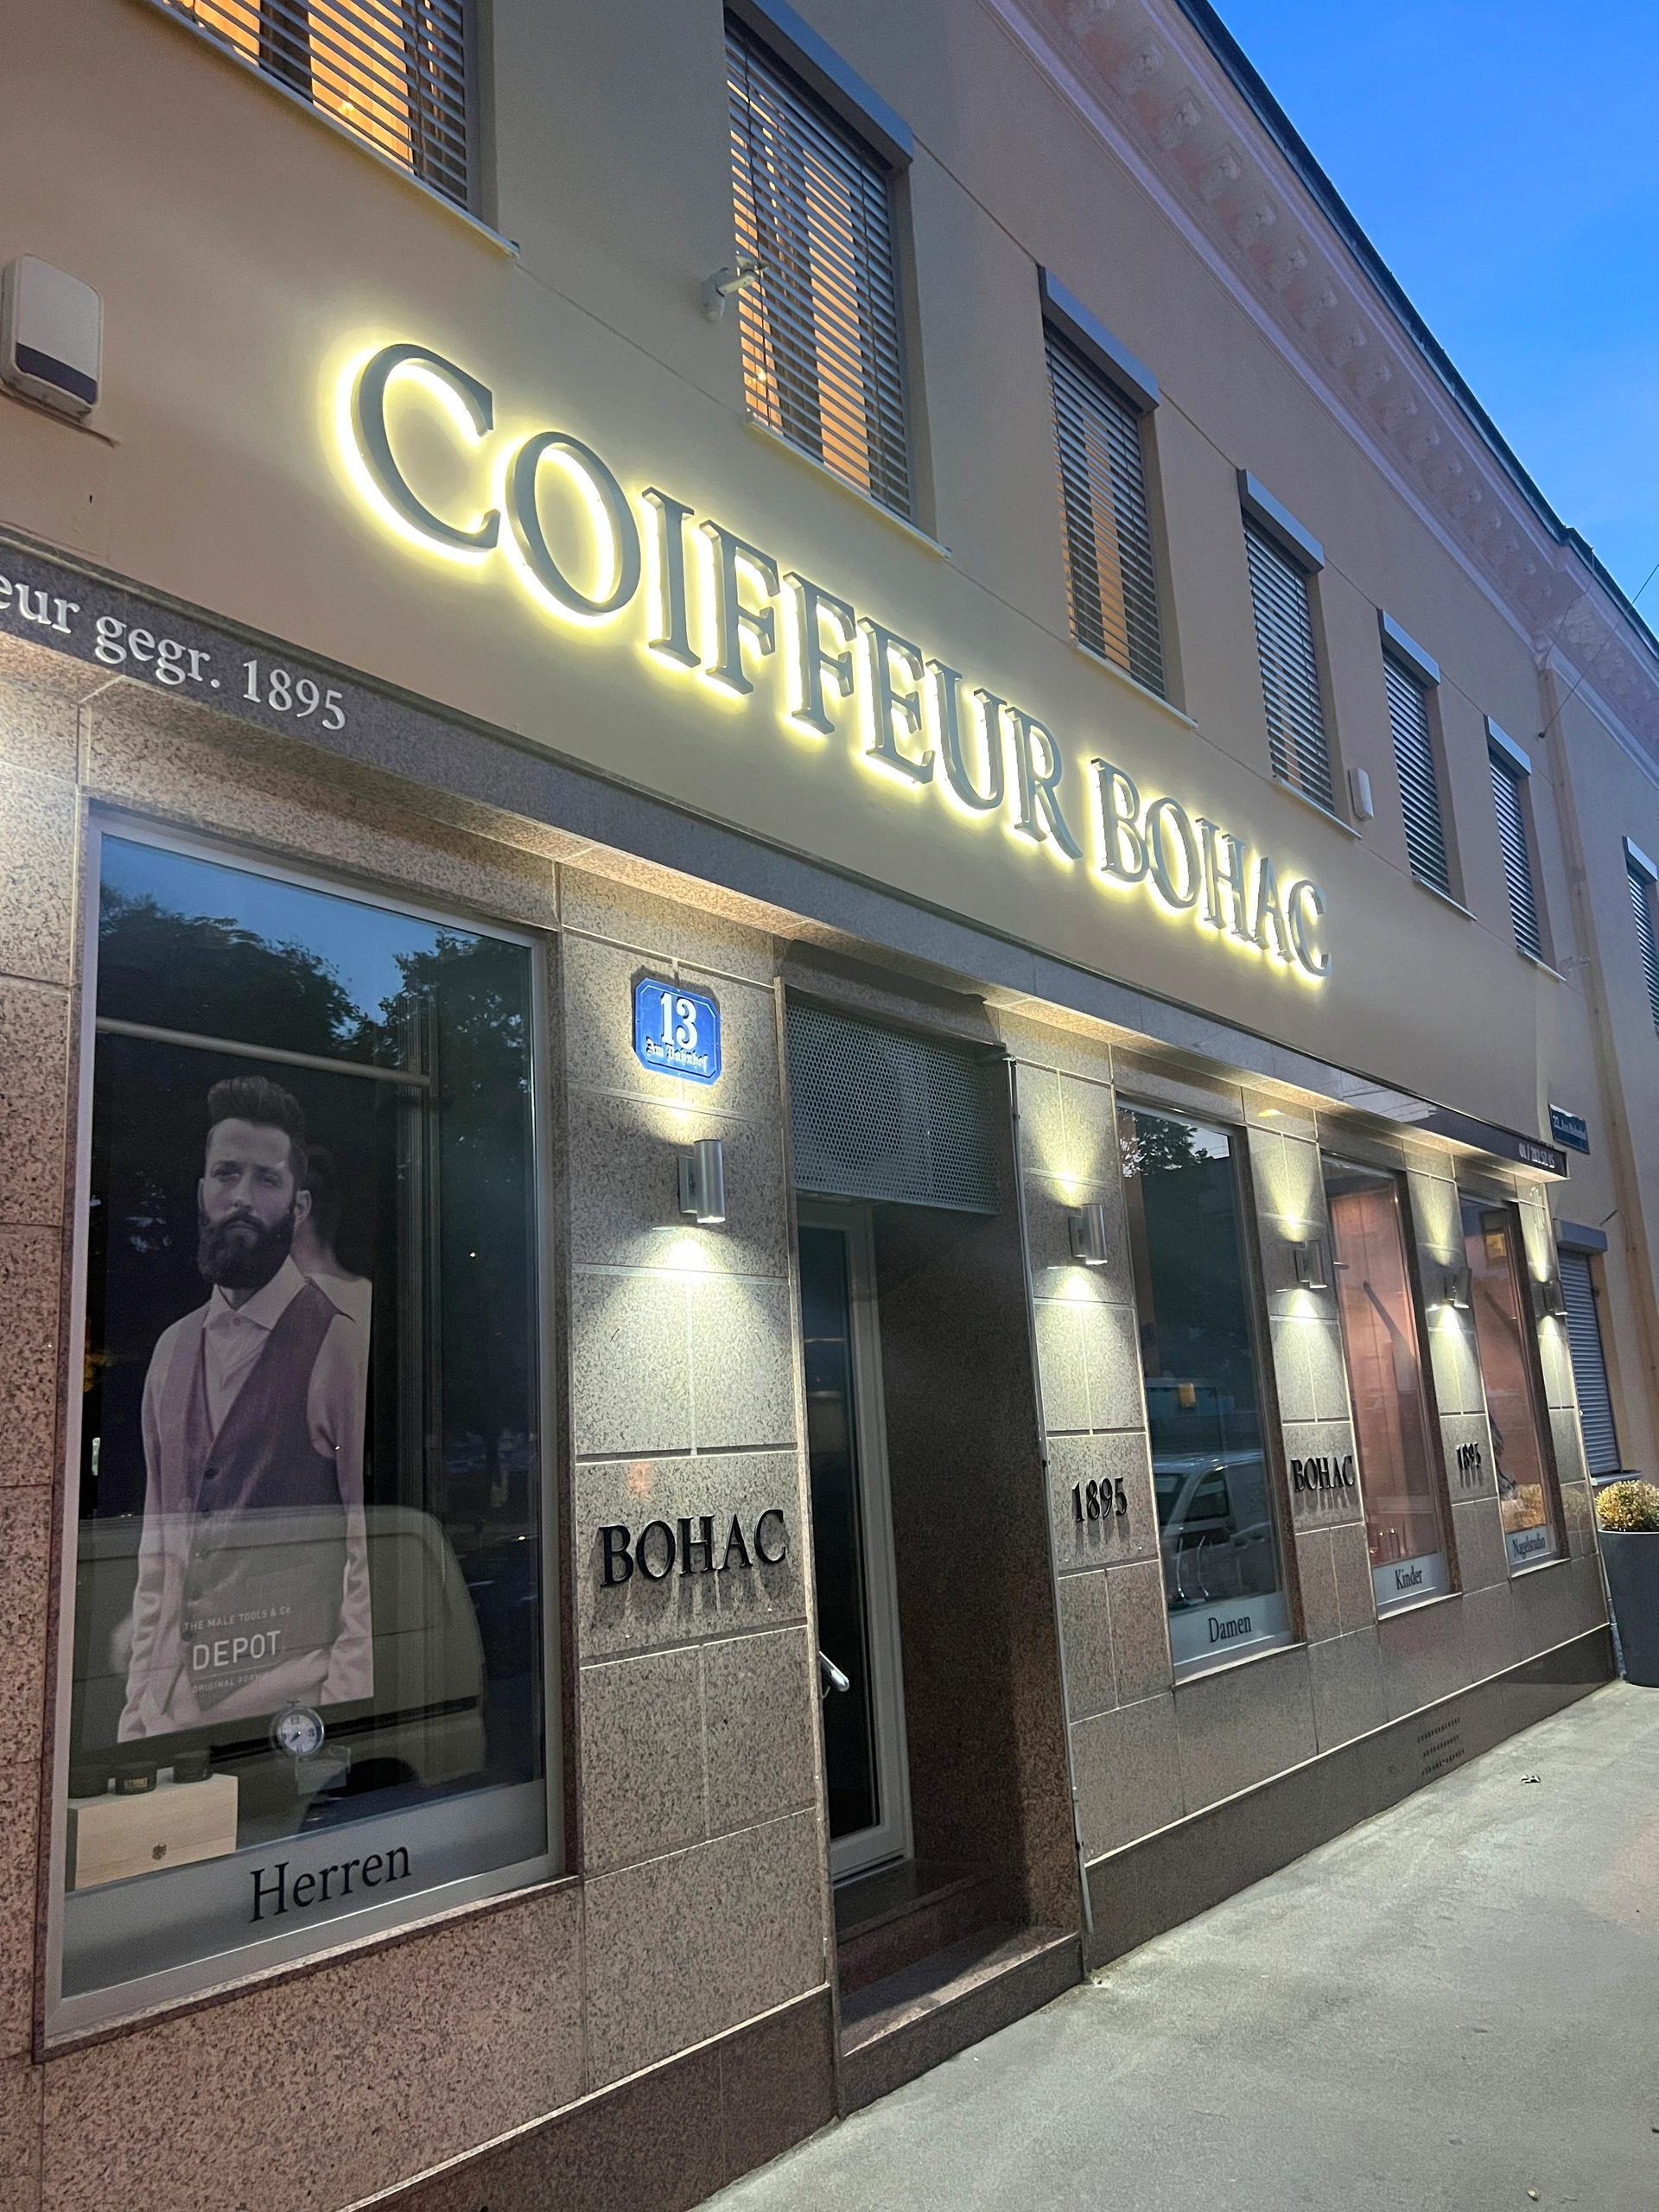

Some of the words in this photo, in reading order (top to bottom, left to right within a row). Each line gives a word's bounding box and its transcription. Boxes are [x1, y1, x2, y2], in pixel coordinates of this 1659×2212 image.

[94, 616, 220, 688] gegr.
[243, 659, 346, 730] 1895
[350, 343, 1083, 861] COIFFEUR
[1091, 758, 1332, 977] BOHAC
[660, 991, 698, 1050] 13
[646, 1036, 664, 1057] Am
[665, 1043, 709, 1072] Bahnhof
[1291, 1455, 1356, 1492] BOHAC
[1456, 1442, 1481, 1471] 1895
[1071, 1476, 1128, 1522] 1895
[598, 1509, 786, 1587] BOHAC
[1395, 1566, 1423, 1590] Kinder
[184, 1620, 204, 1631] THE
[207, 1615, 235, 1628] MALE
[238, 1609, 268, 1622] TOOLS
[270, 1607, 276, 1617] &
[1208, 1615, 1252, 1643] Damen
[192, 1630, 281, 1671] DEPOT
[192, 1678, 236, 1694] ORIGINAL
[249, 1846, 412, 1923] Herren
